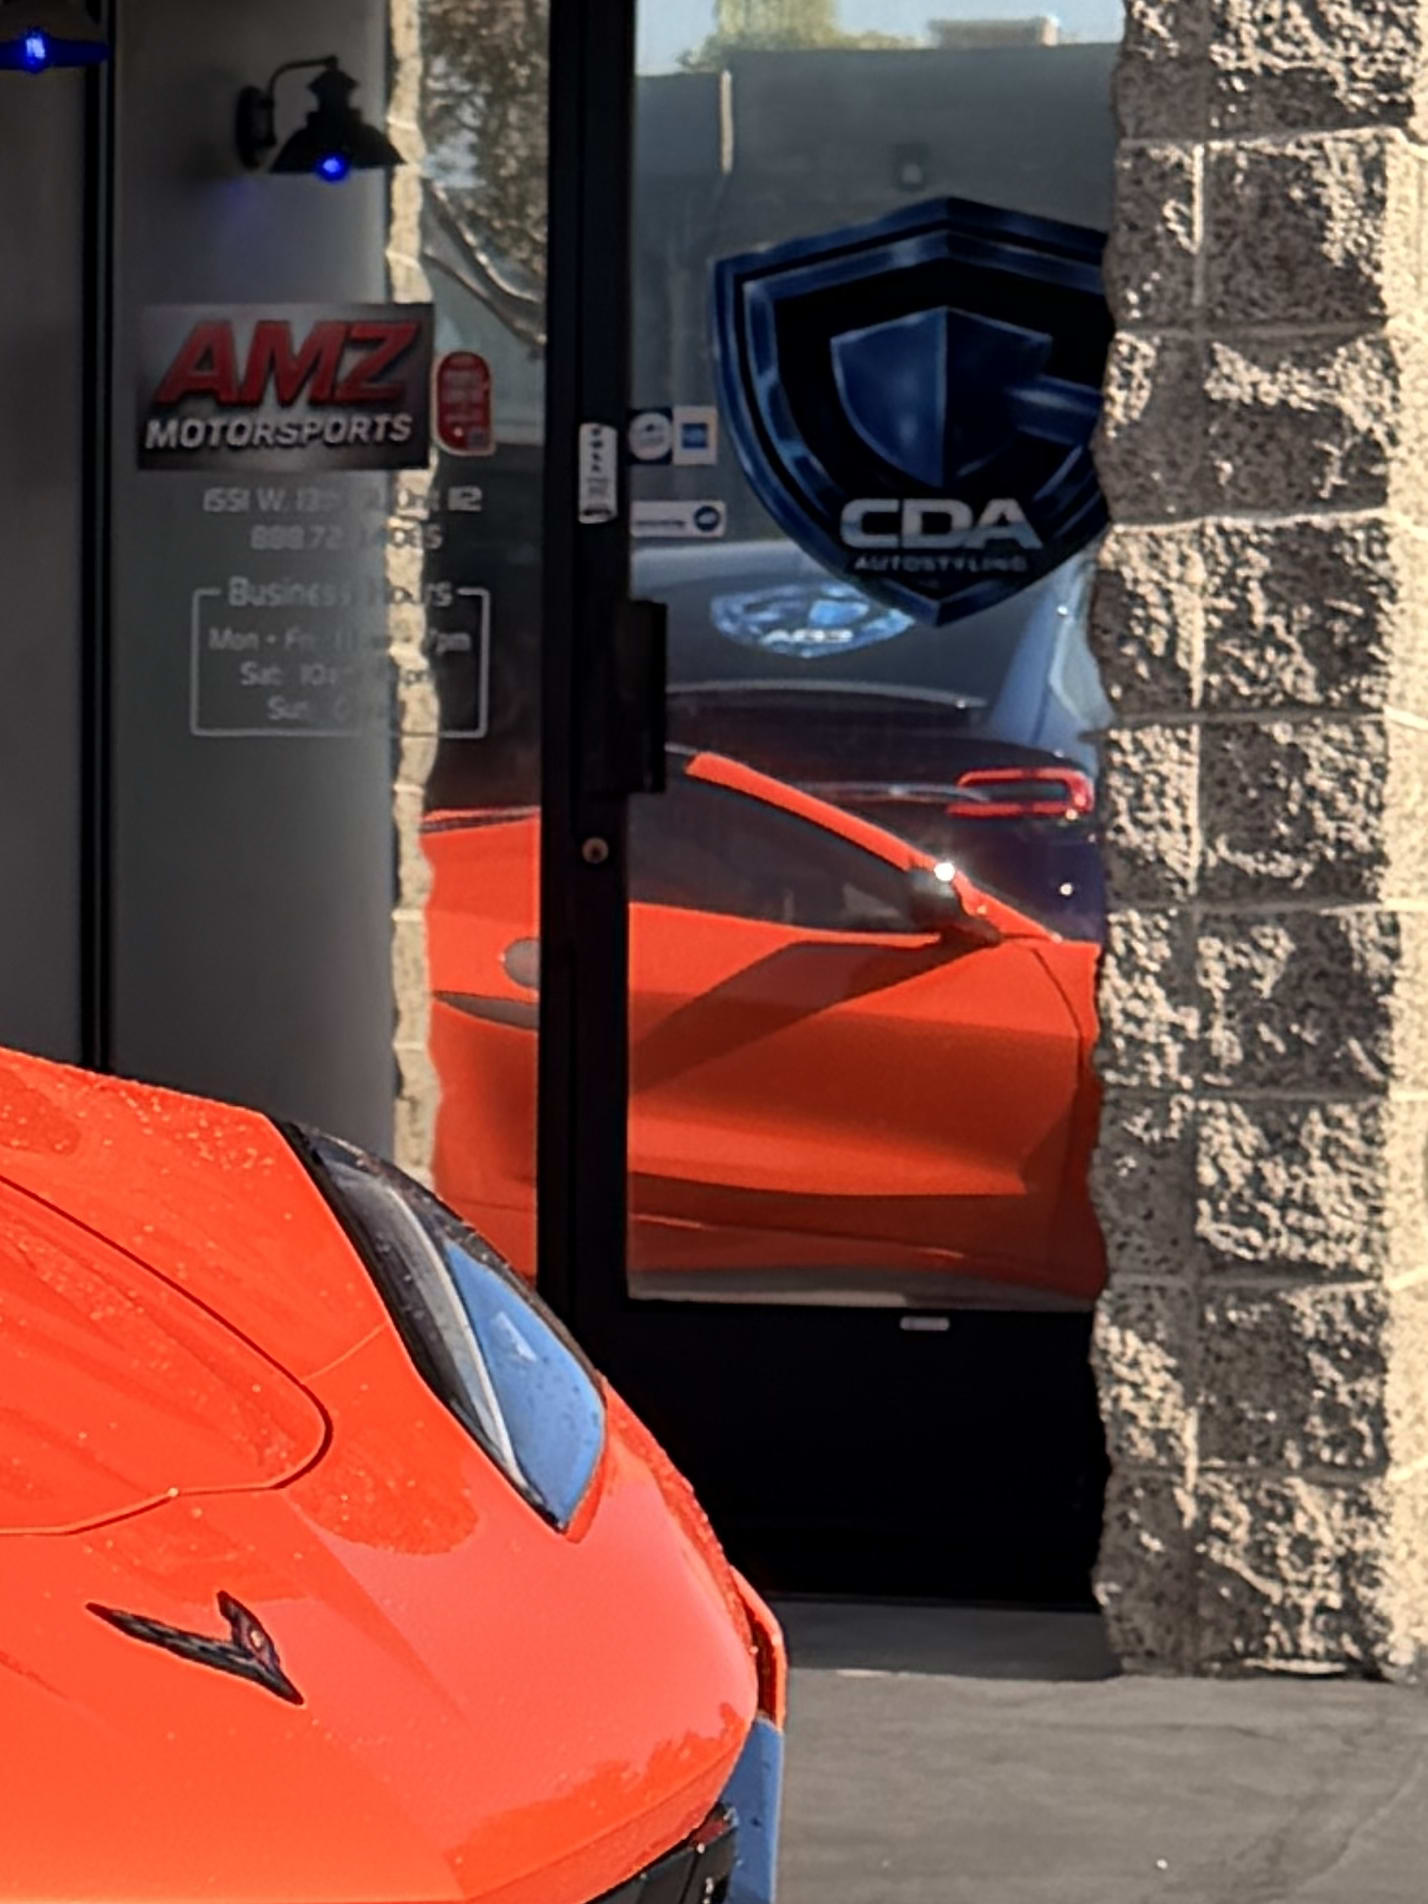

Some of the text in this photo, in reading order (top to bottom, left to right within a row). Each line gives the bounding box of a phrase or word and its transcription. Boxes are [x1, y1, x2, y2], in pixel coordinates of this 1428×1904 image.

[154, 320, 420, 406] AMZ
[145, 413, 413, 448] MOTORSPORTS
[840, 498, 1043, 549] CDA
[854, 554, 1028, 573] AUTOSTYLING
